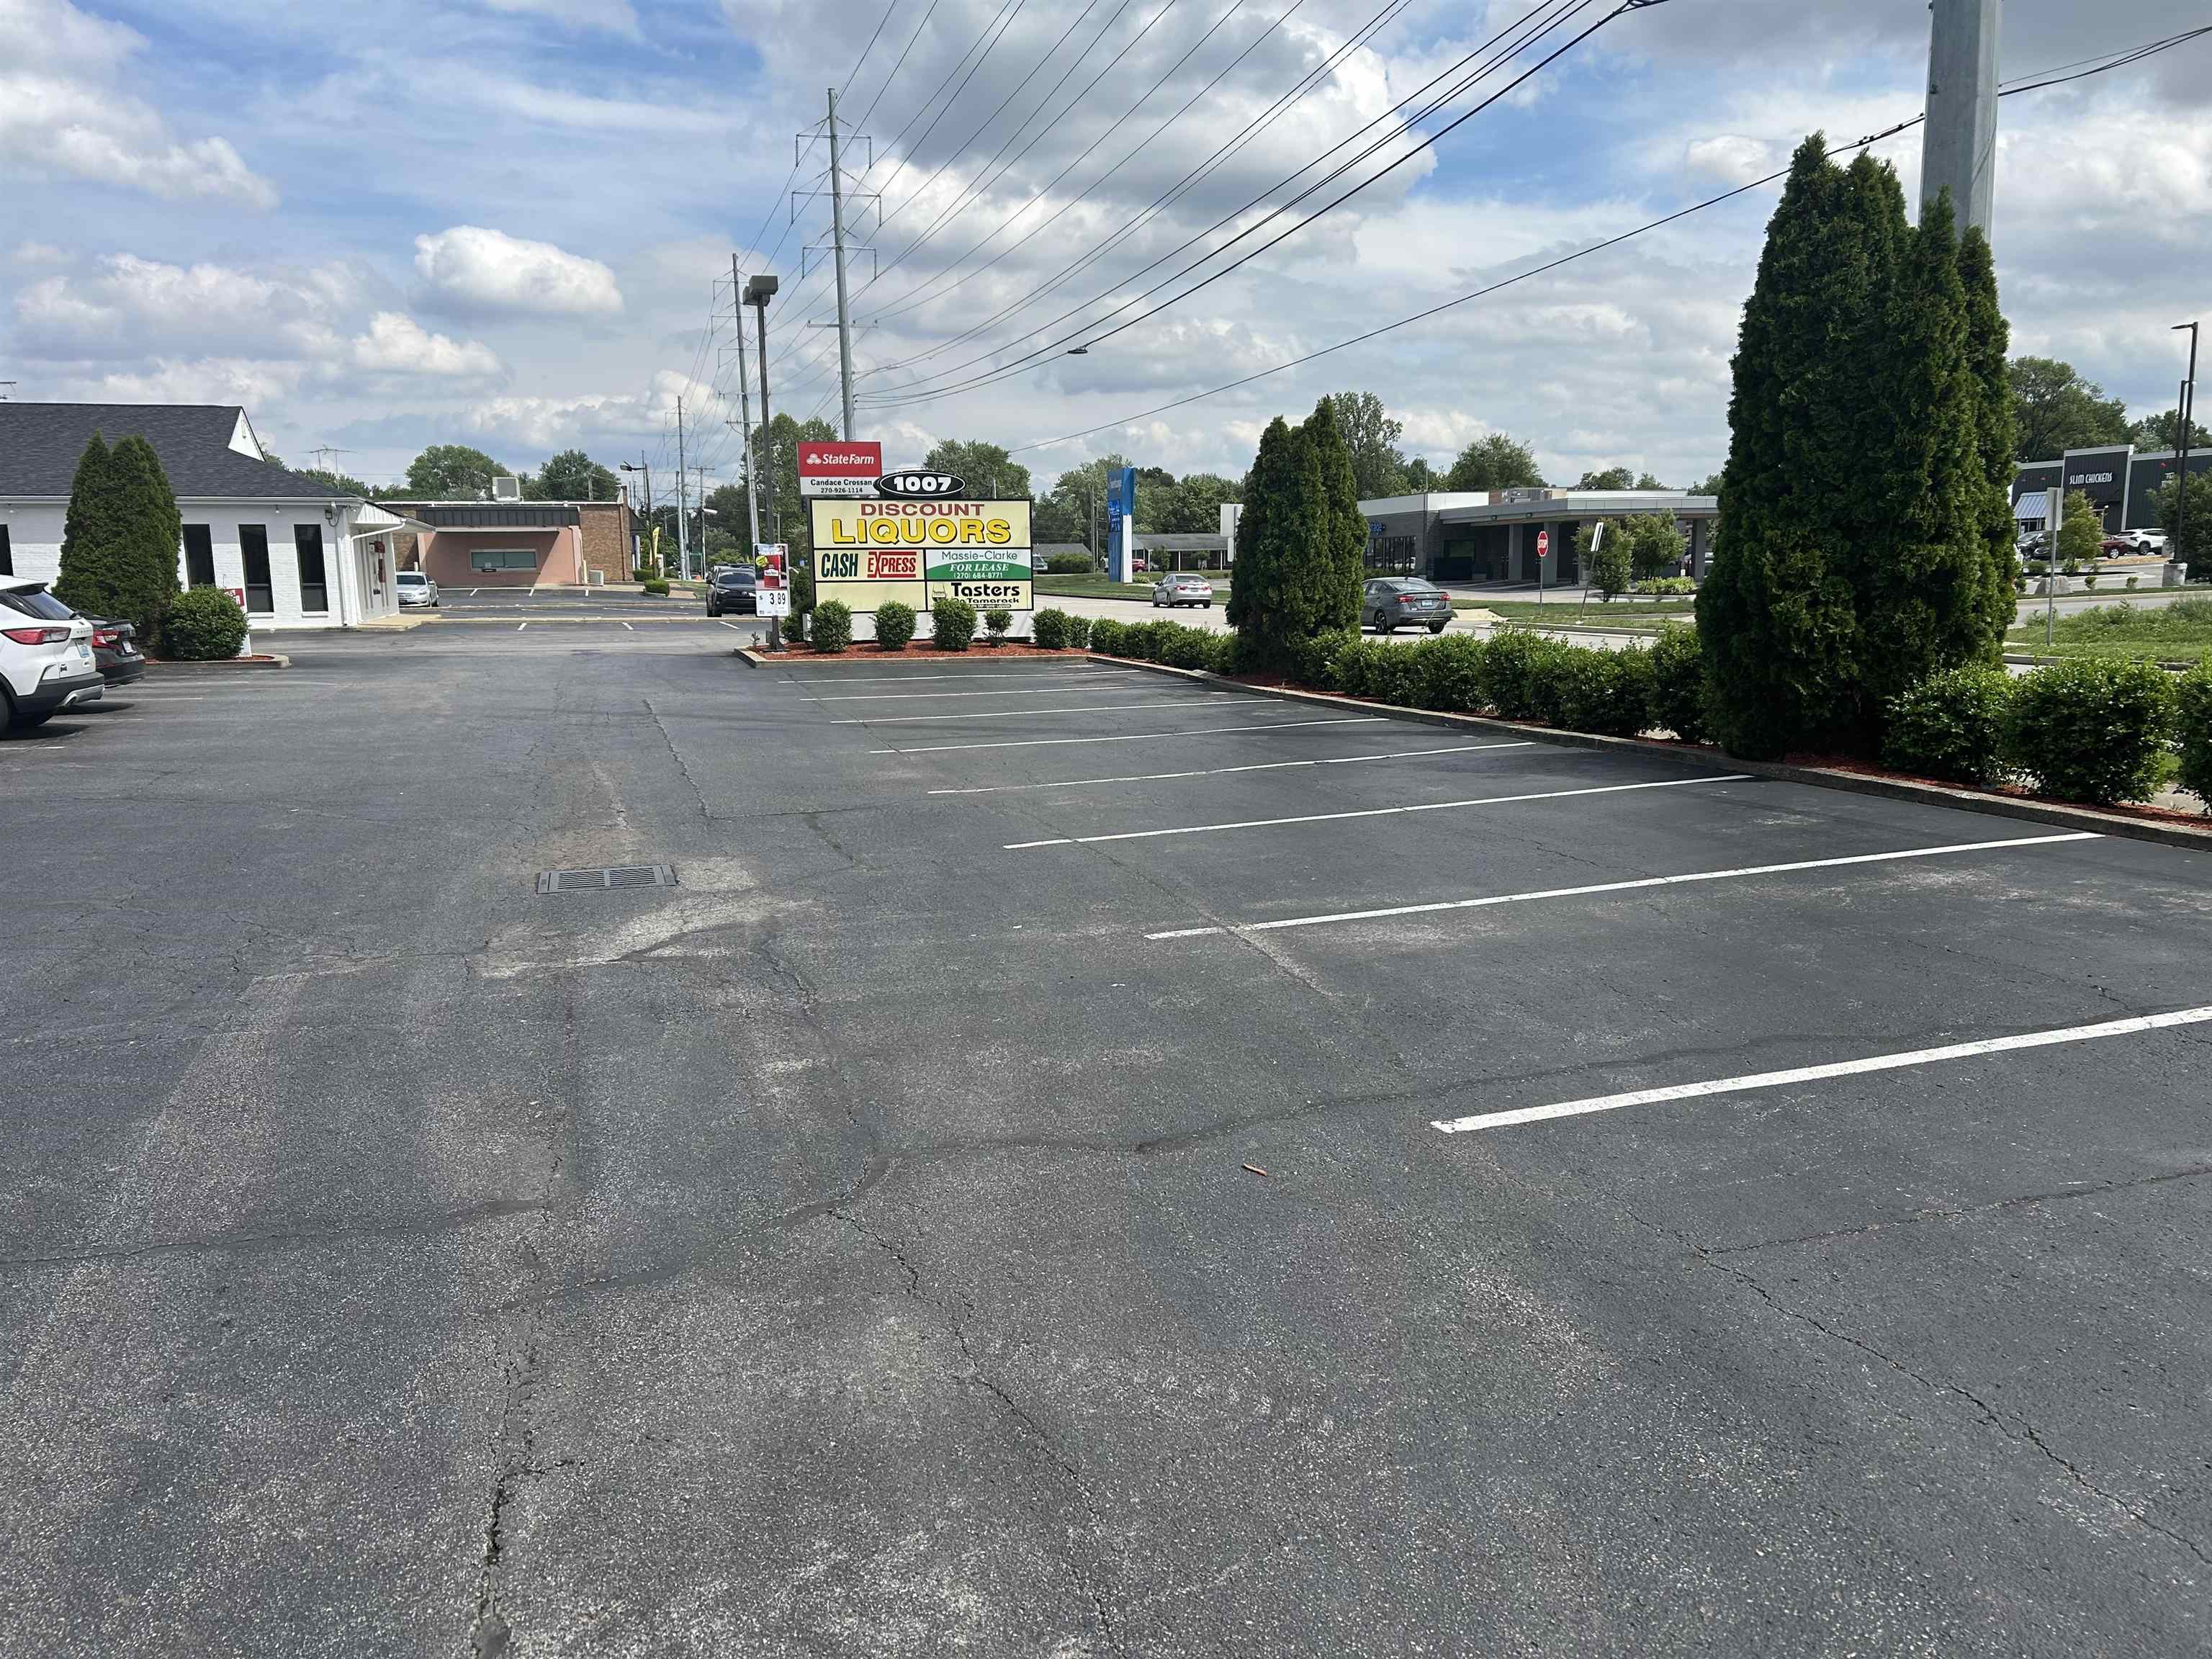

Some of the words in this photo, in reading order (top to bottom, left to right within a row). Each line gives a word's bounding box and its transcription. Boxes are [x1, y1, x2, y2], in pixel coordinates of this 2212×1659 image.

[894, 477, 952, 492] 1007
[2069, 475, 2085, 485] SLIM
[2085, 472, 2113, 484] CHICKENS
[860, 503, 984, 516] DISCOUNT
[832, 518, 1011, 545] LIQUORS
[942, 550, 1017, 560] Massie-Clarke
[821, 553, 858, 577] CASH
[867, 552, 917, 577] EXPRESS
[950, 563, 972, 572] FOR
[974, 563, 1010, 572] LEASE
[951, 582, 1020, 597] Tasters
